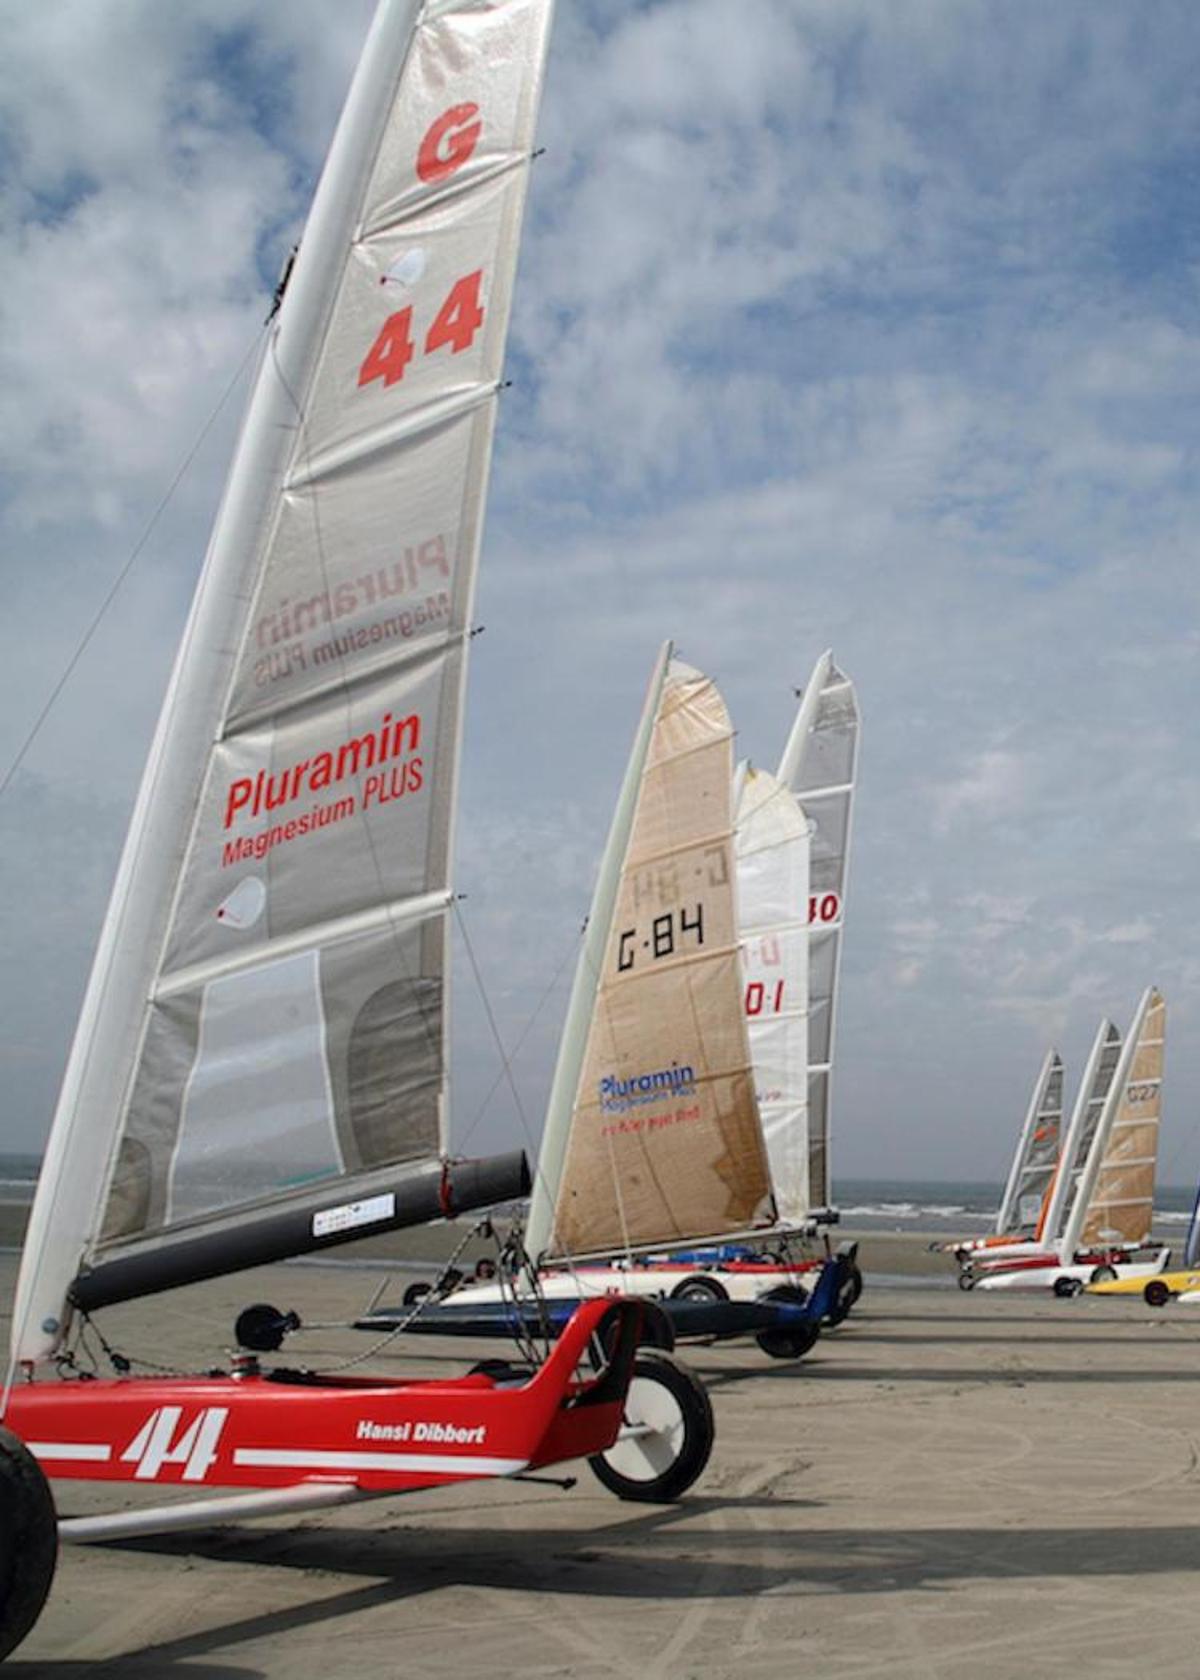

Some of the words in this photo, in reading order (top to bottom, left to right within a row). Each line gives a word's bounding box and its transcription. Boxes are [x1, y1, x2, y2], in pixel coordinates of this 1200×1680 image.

[416, 102, 482, 184] G
[358, 270, 484, 388] 44
[221, 794, 354, 867] Magnesium
[362, 757, 423, 811] PLUS
[223, 712, 421, 829] Pluramin
[120, 1406, 228, 1479] 44
[356, 1420, 411, 1441] Hansi
[413, 1422, 486, 1445] Dibbert
